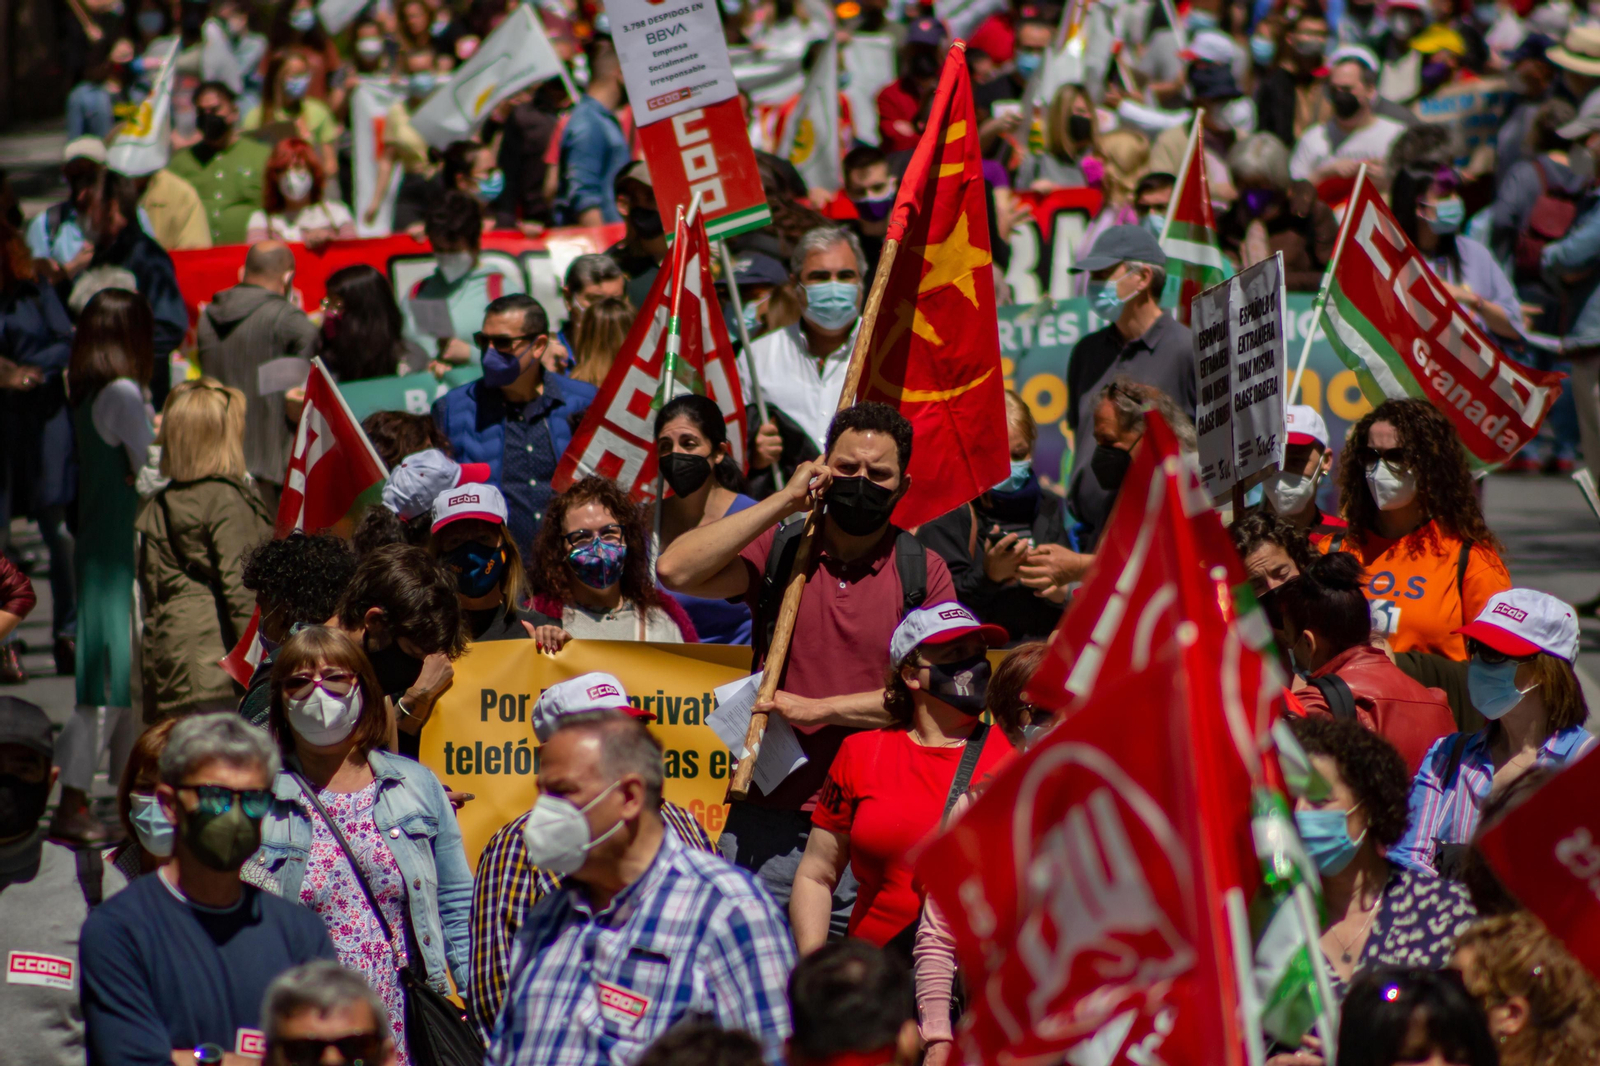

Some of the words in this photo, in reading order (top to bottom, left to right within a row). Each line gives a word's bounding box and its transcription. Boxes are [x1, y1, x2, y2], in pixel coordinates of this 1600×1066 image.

[622, 20, 646, 33] 3.798
[647, 6, 690, 26] DESPIDOS
[691, 2, 704, 12] EN
[645, 22, 688, 45] BBVA
[652, 42, 688, 58] Empresa
[648, 52, 699, 73] Socialmente
[649, 63, 706, 87] Irresponsable
[649, 92, 681, 109] CCOO
[1354, 199, 1550, 428] CCOO
[999, 312, 1080, 350] RTES
[1238, 358, 1252, 383] UNA
[1234, 385, 1253, 413] CLASE
[1253, 375, 1278, 404] OBRERA
[1412, 337, 1520, 453] Granada
[450, 494, 479, 506] CCOO
[1494, 603, 1525, 620] CCOO
[480, 688, 530, 722] Por
[664, 749, 699, 779] as
[13, 957, 60, 975] CCOO
